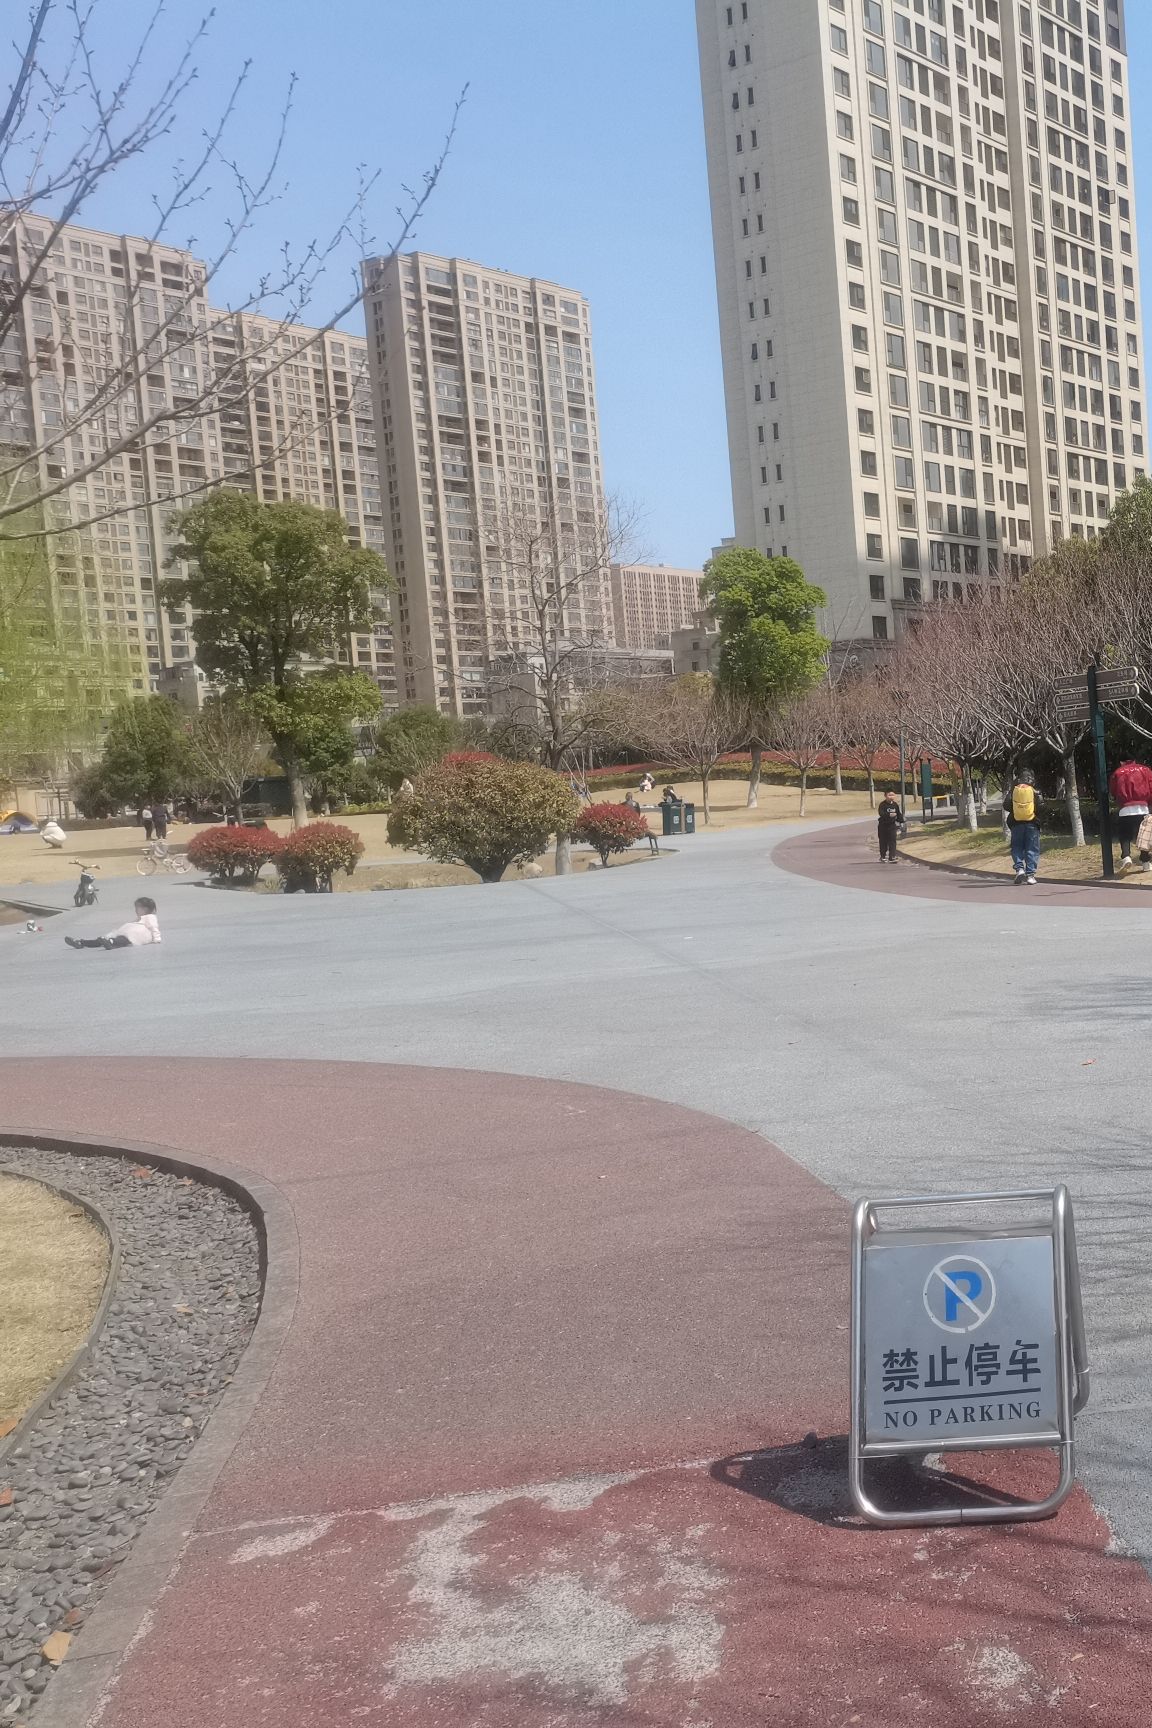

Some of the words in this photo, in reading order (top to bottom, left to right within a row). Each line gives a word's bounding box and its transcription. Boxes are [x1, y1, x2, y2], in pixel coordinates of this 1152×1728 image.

[882, 1339, 1042, 1393] 禁止停车
[884, 1411, 919, 1429] NO
[929, 1401, 1041, 1426] PARKING
